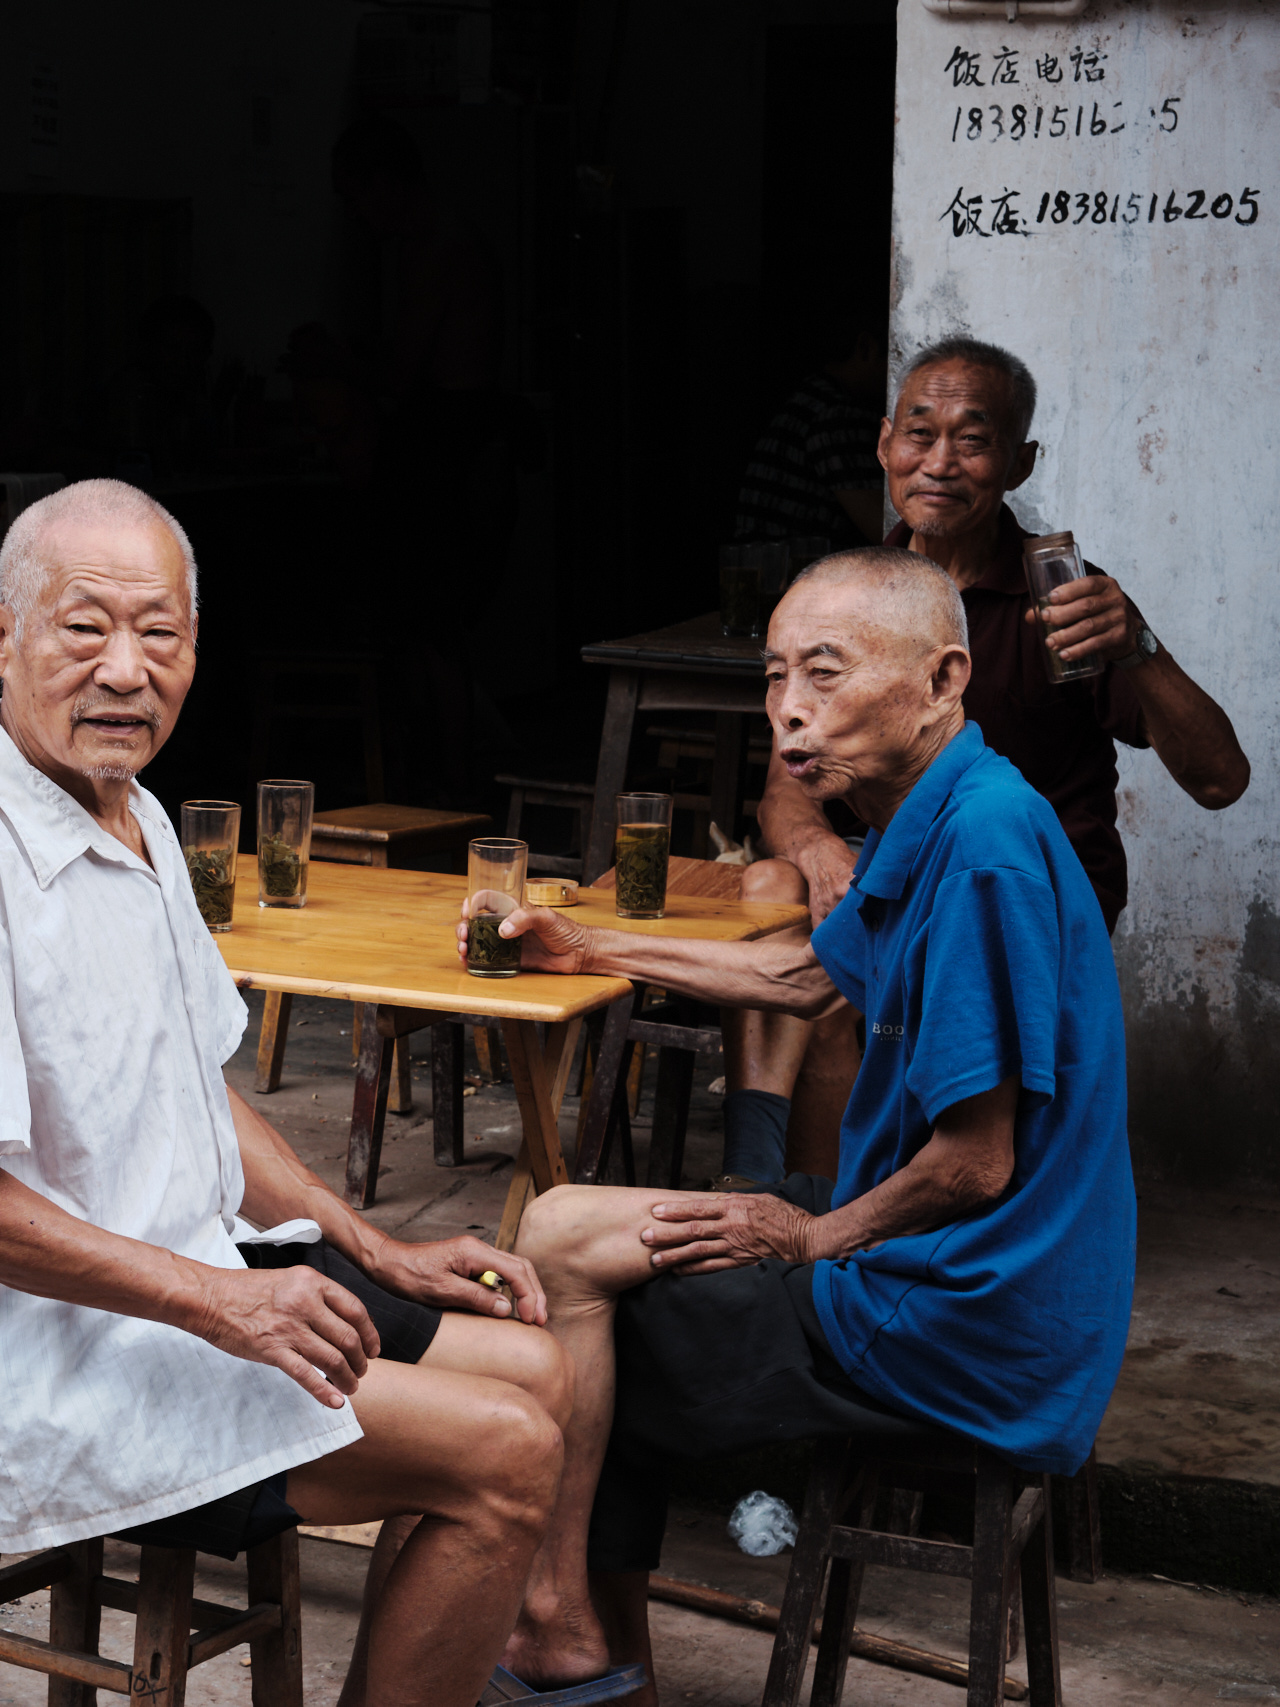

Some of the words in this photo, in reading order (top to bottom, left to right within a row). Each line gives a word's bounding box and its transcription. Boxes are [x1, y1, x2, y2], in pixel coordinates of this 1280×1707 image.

[944, 46, 1108, 87] 饭店电话
[952, 98, 1181, 142] 183815165
